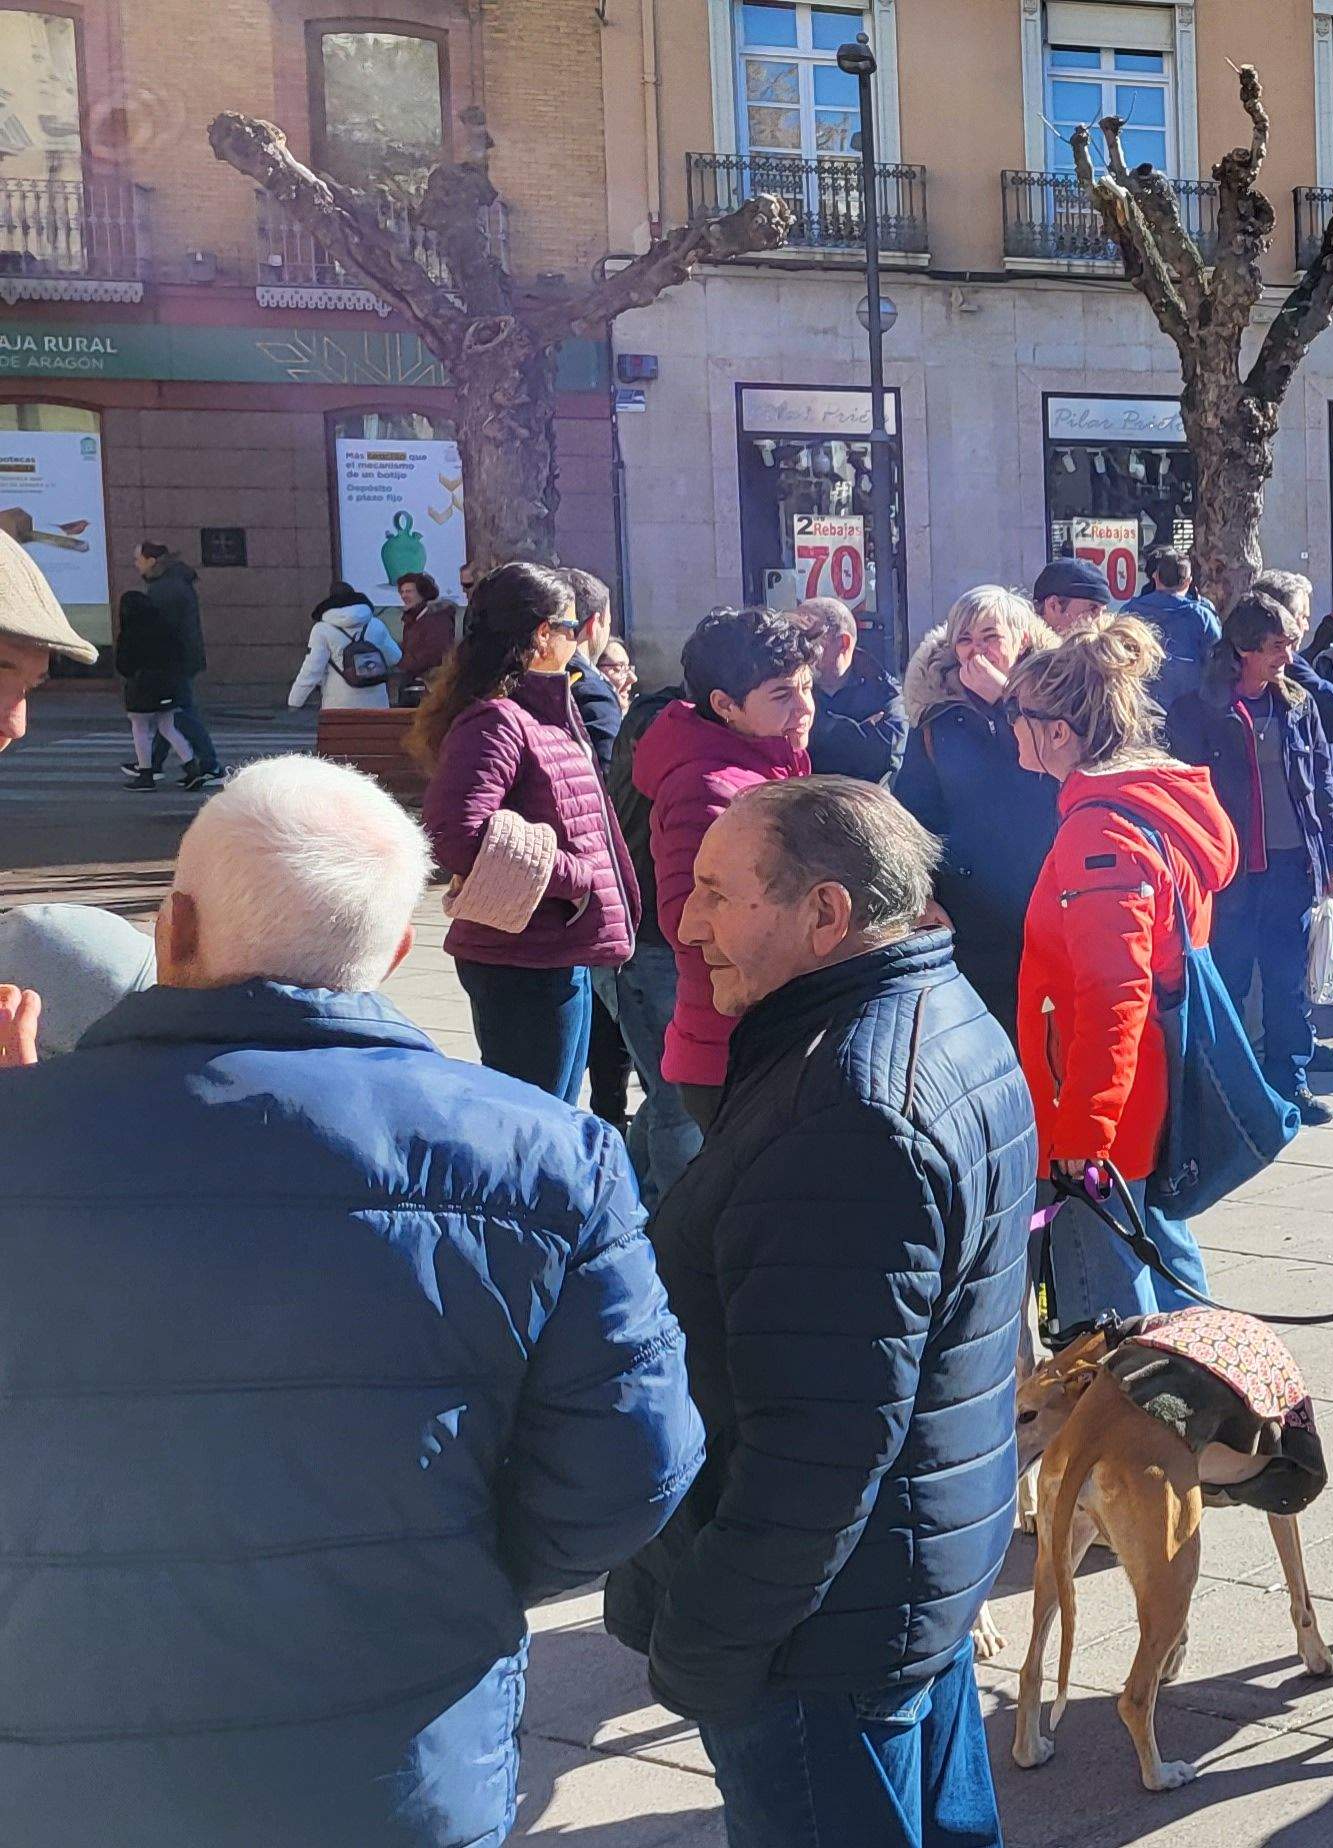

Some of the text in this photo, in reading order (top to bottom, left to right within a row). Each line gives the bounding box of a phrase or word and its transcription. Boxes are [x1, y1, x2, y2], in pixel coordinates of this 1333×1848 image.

[44, 336, 118, 353] RURAL
[813, 523, 863, 539] Rebajas
[1091, 524, 1136, 541] Rebajas
[797, 545, 863, 600] 70
